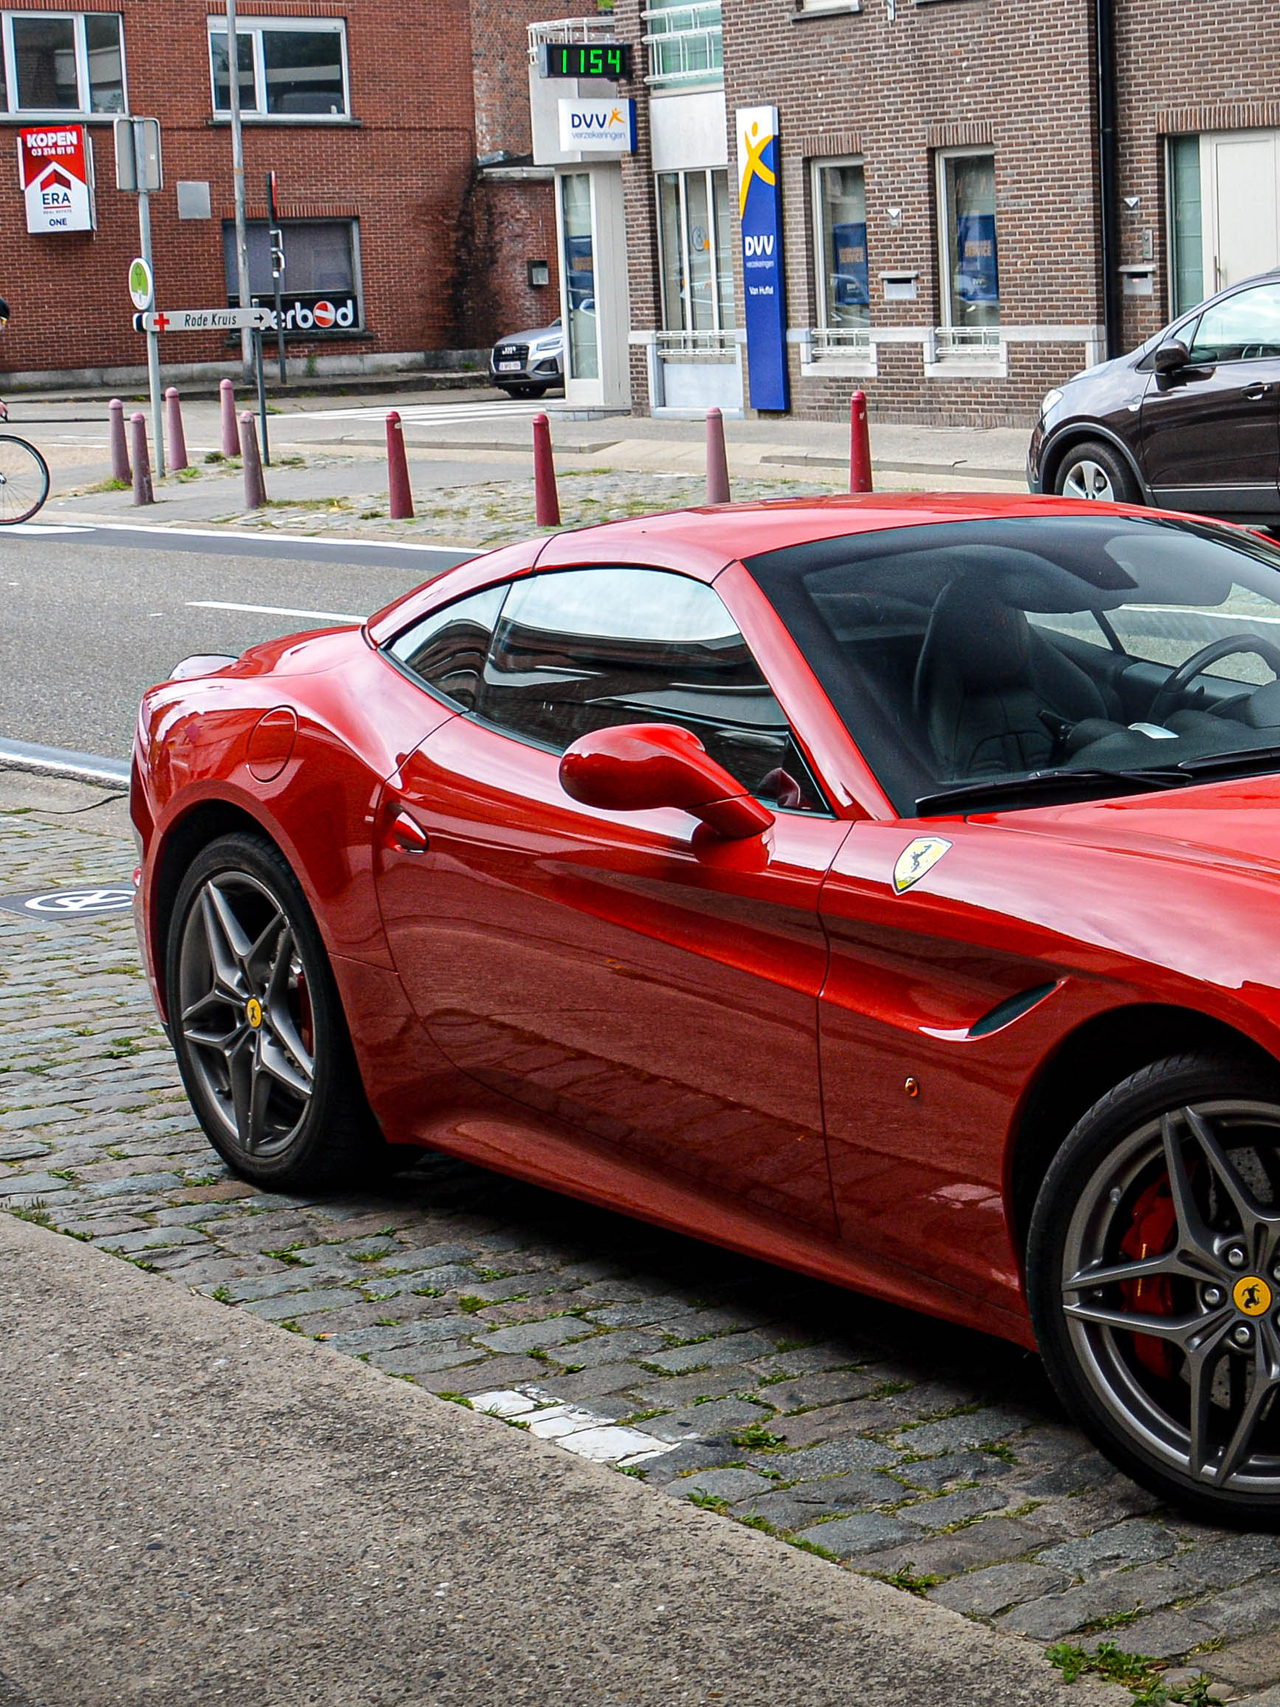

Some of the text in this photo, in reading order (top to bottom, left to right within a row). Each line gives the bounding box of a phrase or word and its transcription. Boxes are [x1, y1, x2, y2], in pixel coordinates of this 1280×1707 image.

[571, 113, 607, 129] DVV
[26, 131, 78, 148] KOPEN
[571, 131, 626, 141] verzekeringen
[42, 192, 71, 205] ERA
[49, 218, 67, 227] ONE
[745, 235, 774, 256] DVV
[184, 312, 237, 327] Rode Kruis
